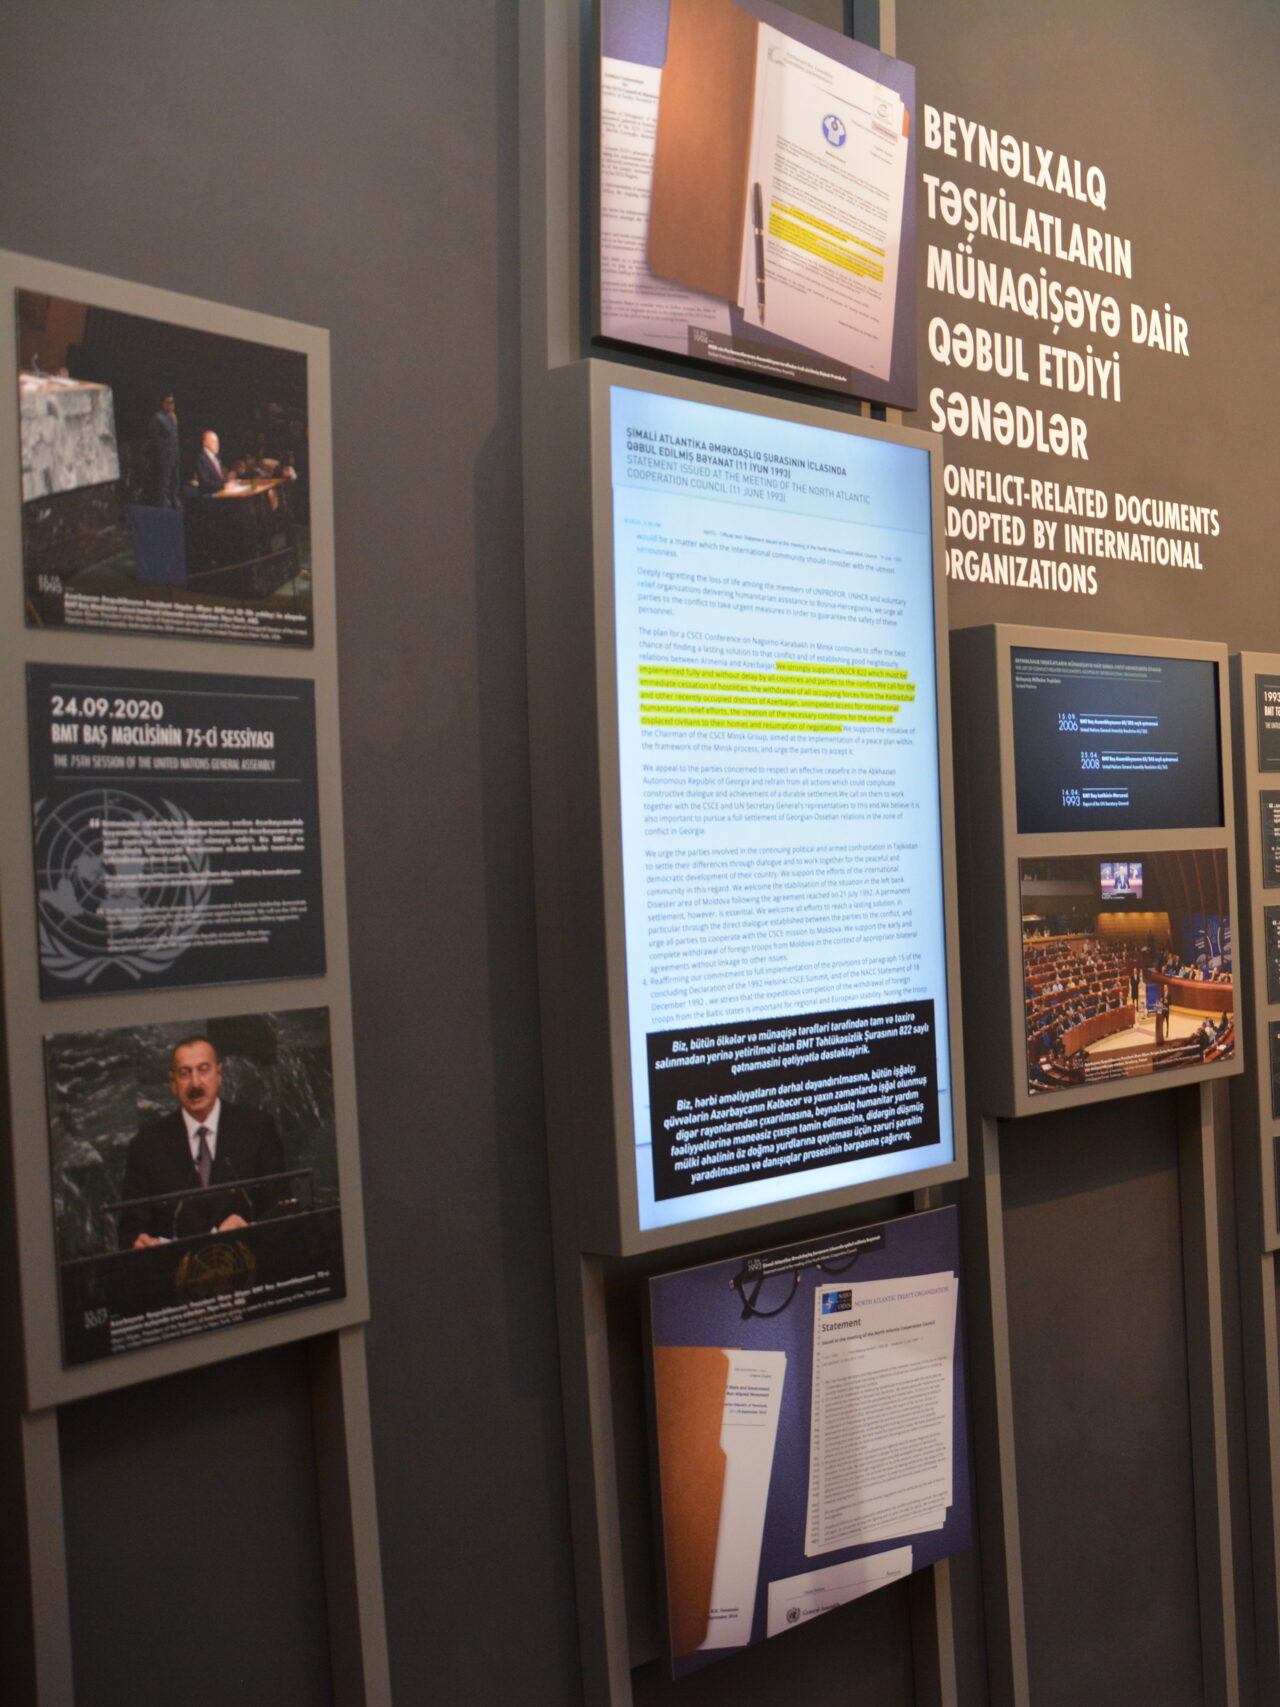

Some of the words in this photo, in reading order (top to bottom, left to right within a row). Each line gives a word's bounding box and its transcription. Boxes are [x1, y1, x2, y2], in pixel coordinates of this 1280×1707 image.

[924, 104, 1107, 211] BEYNƏLXALQ
[923, 173, 1132, 280] TƏŞKİLATLARIN
[927, 242, 1121, 338] MÜNAQİŞƏYƏ
[1130, 302, 1190, 357] DAİR
[928, 317, 1029, 382] QƏBUL
[1039, 343, 1121, 403] ETDİYİ
[929, 387, 1089, 461] SƏNƏDLƏR
[626, 427, 657, 442] ŞİMALİ
[659, 434, 707, 451] ATLANTİKA
[708, 442, 762, 461] ƏMƏKDAŞLIQ
[763, 453, 806, 469] ŞURASININ
[807, 461, 847, 476] İCLASINDA
[626, 441, 657, 455] QƏBUL
[659, 446, 694, 463] EDİLMİŞ
[696, 453, 734, 468] BƏYANAT
[749, 463, 769, 475] İYUN
[626, 454, 678, 471] STATEMENT
[680, 463, 711, 478] ISSUED
[712, 469, 722, 479] AT
[724, 470, 740, 483] THE
[742, 474, 778, 489] MEETING
[779, 480, 790, 490] OF
[792, 482, 807, 494] THE
[808, 485, 835, 498] NORTH
[836, 490, 871, 505] ATLANTIC
[626, 467, 689, 487] COOPERATION
[690, 478, 728, 494] COUNCIL
[743, 487, 764, 500] JUNE
[944, 464, 1108, 519] ONFLICT-RELATED
[1115, 495, 1221, 537] DOCUMENTS
[945, 507, 1025, 546] DOPTED
[1033, 519, 1056, 551] BY
[1065, 525, 1203, 570] INTERNATIONAL
[51, 695, 164, 720] 24.09.2020
[1058, 719, 1079, 732] 2006
[51, 723, 79, 744] BMT
[83, 724, 108, 748] BAŞ
[111, 723, 183, 747] MƏCLİSİNİN
[186, 726, 218, 748] 75-Cİ
[220, 727, 275, 749] SESSİYASI
[1081, 758, 1100, 770] 2008
[1062, 795, 1081, 807] 1993
[672, 1040, 689, 1053] Biz,
[690, 1037, 716, 1051] bütün
[716, 1034, 747, 1047] ölkələr
[747, 1033, 758, 1043] və
[869, 1017, 885, 1027] tam
[885, 1016, 894, 1025] və
[894, 1012, 916, 1024] təxirə
[706, 1050, 734, 1065] yerinə
[777, 1041, 796, 1053] olan
[796, 1037, 815, 1051] BMT
[899, 1024, 913, 1036] 822
[913, 1023, 930, 1035] saylı
[676, 1099, 693, 1112] Biz,
[694, 1094, 718, 1109] hərbi
[777, 1081, 804, 1095] dərhal
[871, 1067, 893, 1080] bütün
[893, 1064, 916, 1078] işğalçı
[803, 1095, 813, 1104] və
[813, 1092, 834, 1106] yaxın
[878, 1079, 896, 1094] işğal
[896, 1076, 928, 1089] olunmuş
[675, 1128, 700, 1142] digər
[894, 1090, 919, 1105] yardım
[772, 1126, 798, 1140] çıxışın
[799, 1120, 822, 1133] təmin
[896, 1101, 925, 1116] düşmüş
[674, 1156, 700, 1171] mülki
[736, 1148, 747, 1160] öz
[747, 1144, 775, 1158] doğma
[854, 1124, 872, 1138] üçün
[872, 1119, 895, 1133] zəruri
[751, 1161, 762, 1170] və
[821, 1318, 862, 1333] Statement
